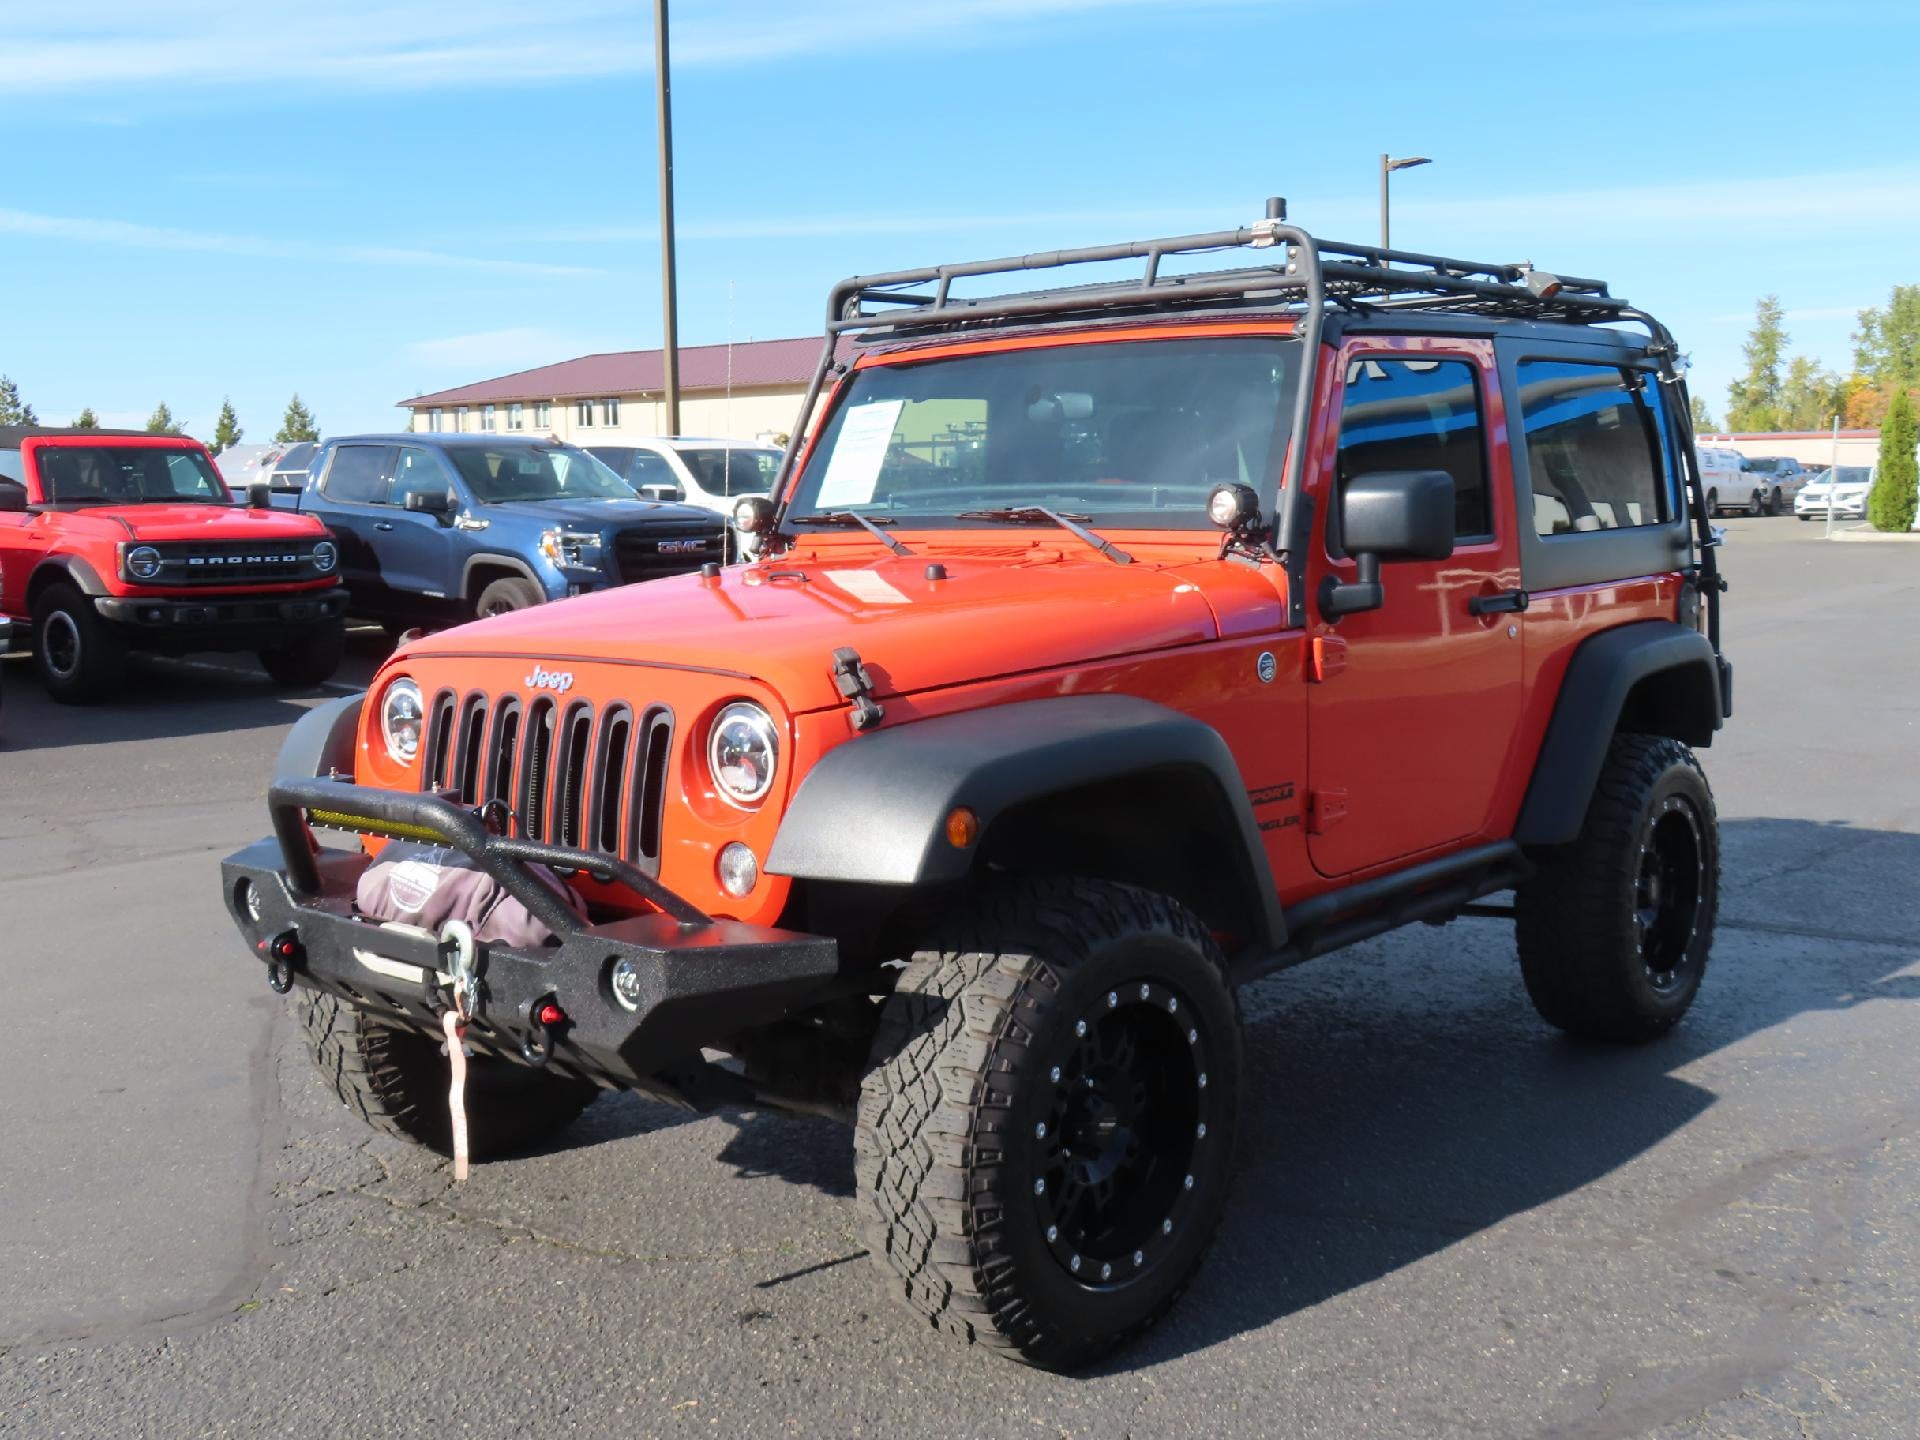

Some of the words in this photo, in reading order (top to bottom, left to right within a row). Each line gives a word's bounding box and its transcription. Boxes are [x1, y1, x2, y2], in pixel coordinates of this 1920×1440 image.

[658, 540, 706, 553] GMC
[189, 556, 296, 565] BRONCO
[525, 665, 573, 694] Jeep
[1248, 783, 1294, 805] PORT
